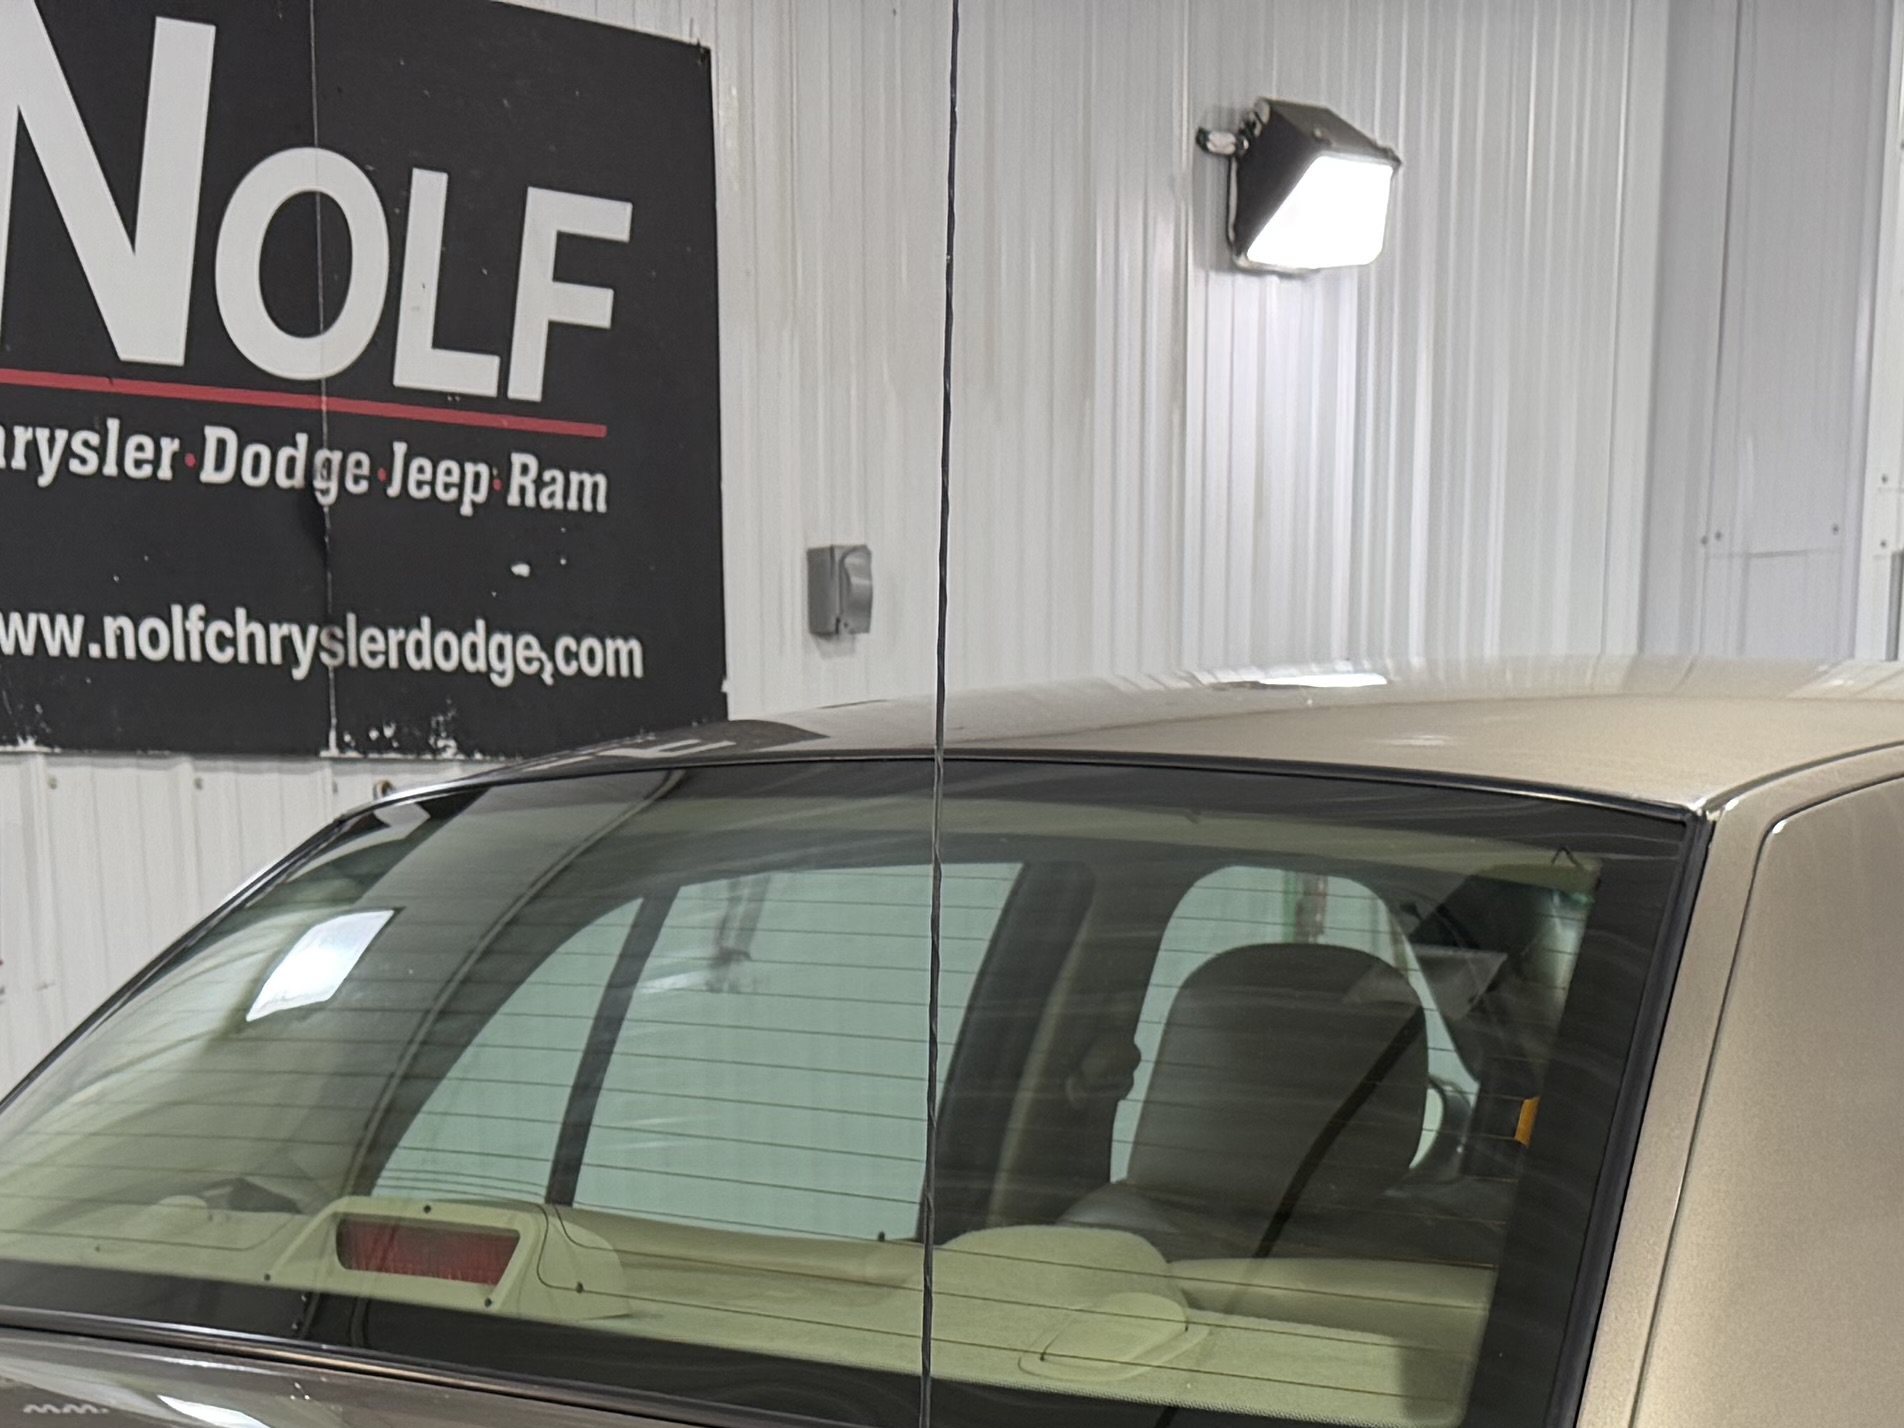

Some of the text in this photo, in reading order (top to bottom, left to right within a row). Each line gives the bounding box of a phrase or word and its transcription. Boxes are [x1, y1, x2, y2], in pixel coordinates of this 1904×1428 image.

[200, 426, 371, 506] Dodge
[386, 442, 492, 517] Jeep
[507, 453, 609, 514] Ram
